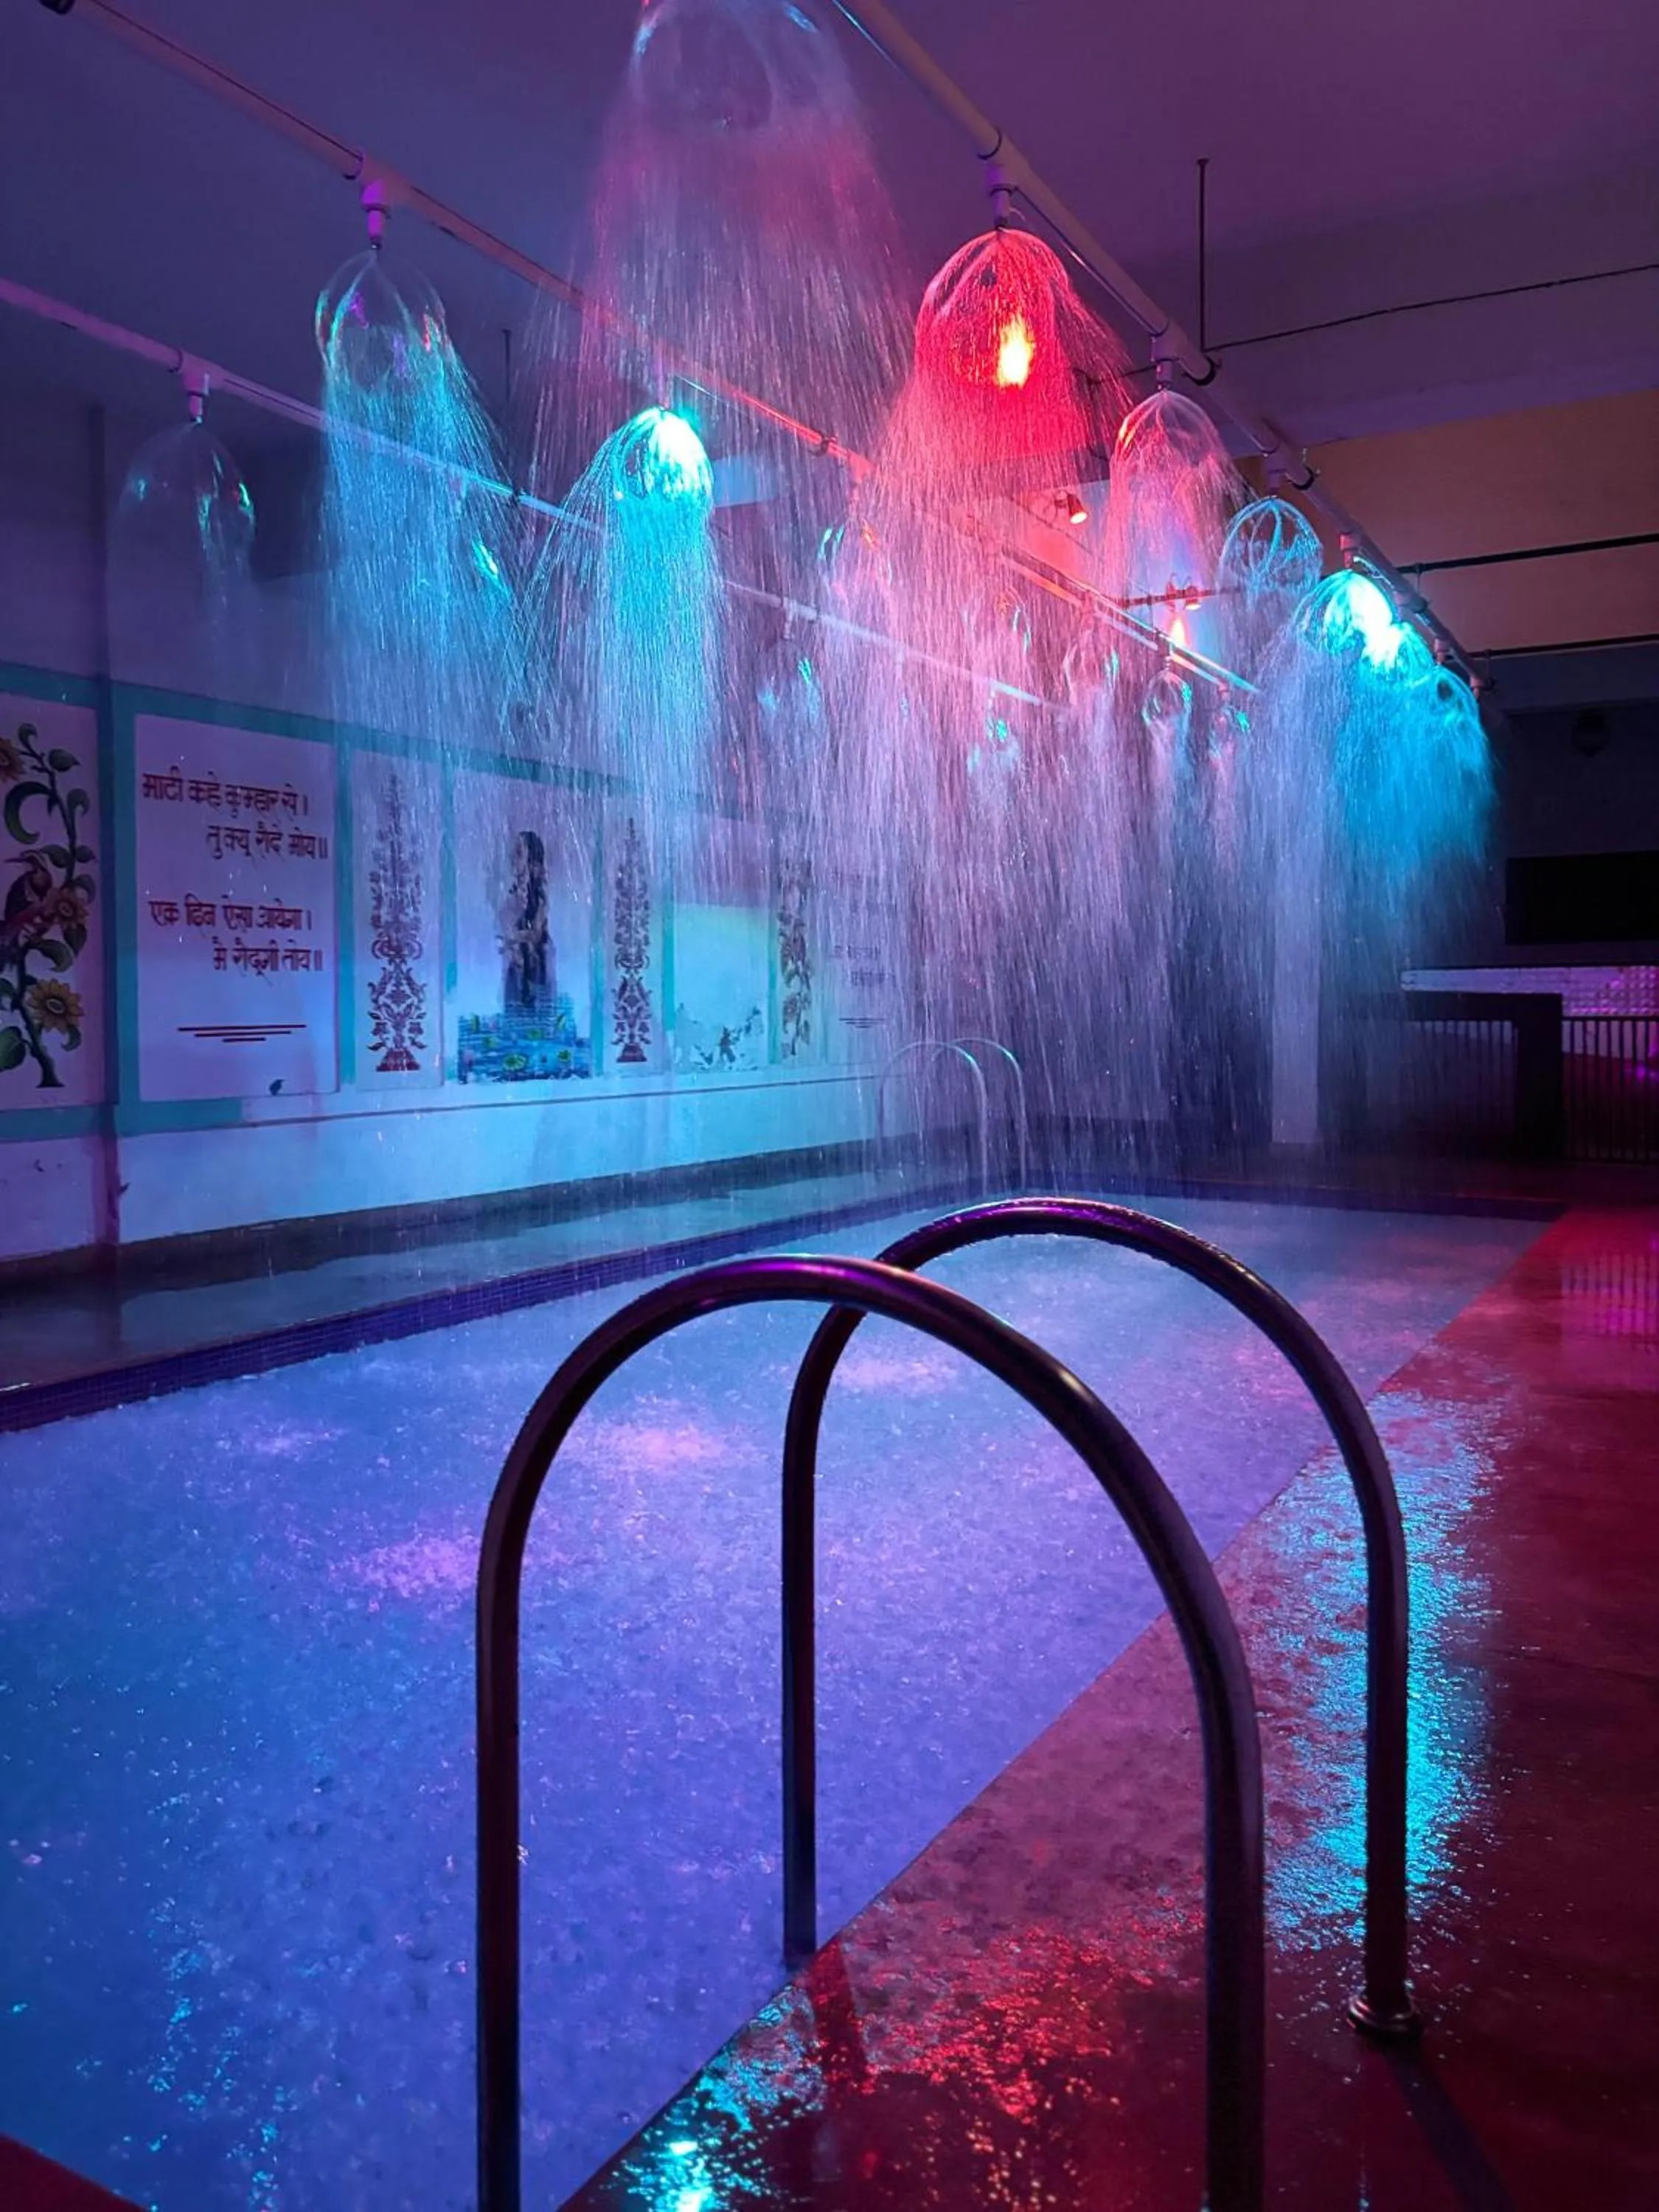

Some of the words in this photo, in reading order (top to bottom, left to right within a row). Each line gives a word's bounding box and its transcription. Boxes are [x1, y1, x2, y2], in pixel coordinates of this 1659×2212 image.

[142, 765, 183, 802] माटी
[188, 771, 221, 811] कहे
[148, 900, 180, 927] एक
[184, 892, 216, 928] दिन
